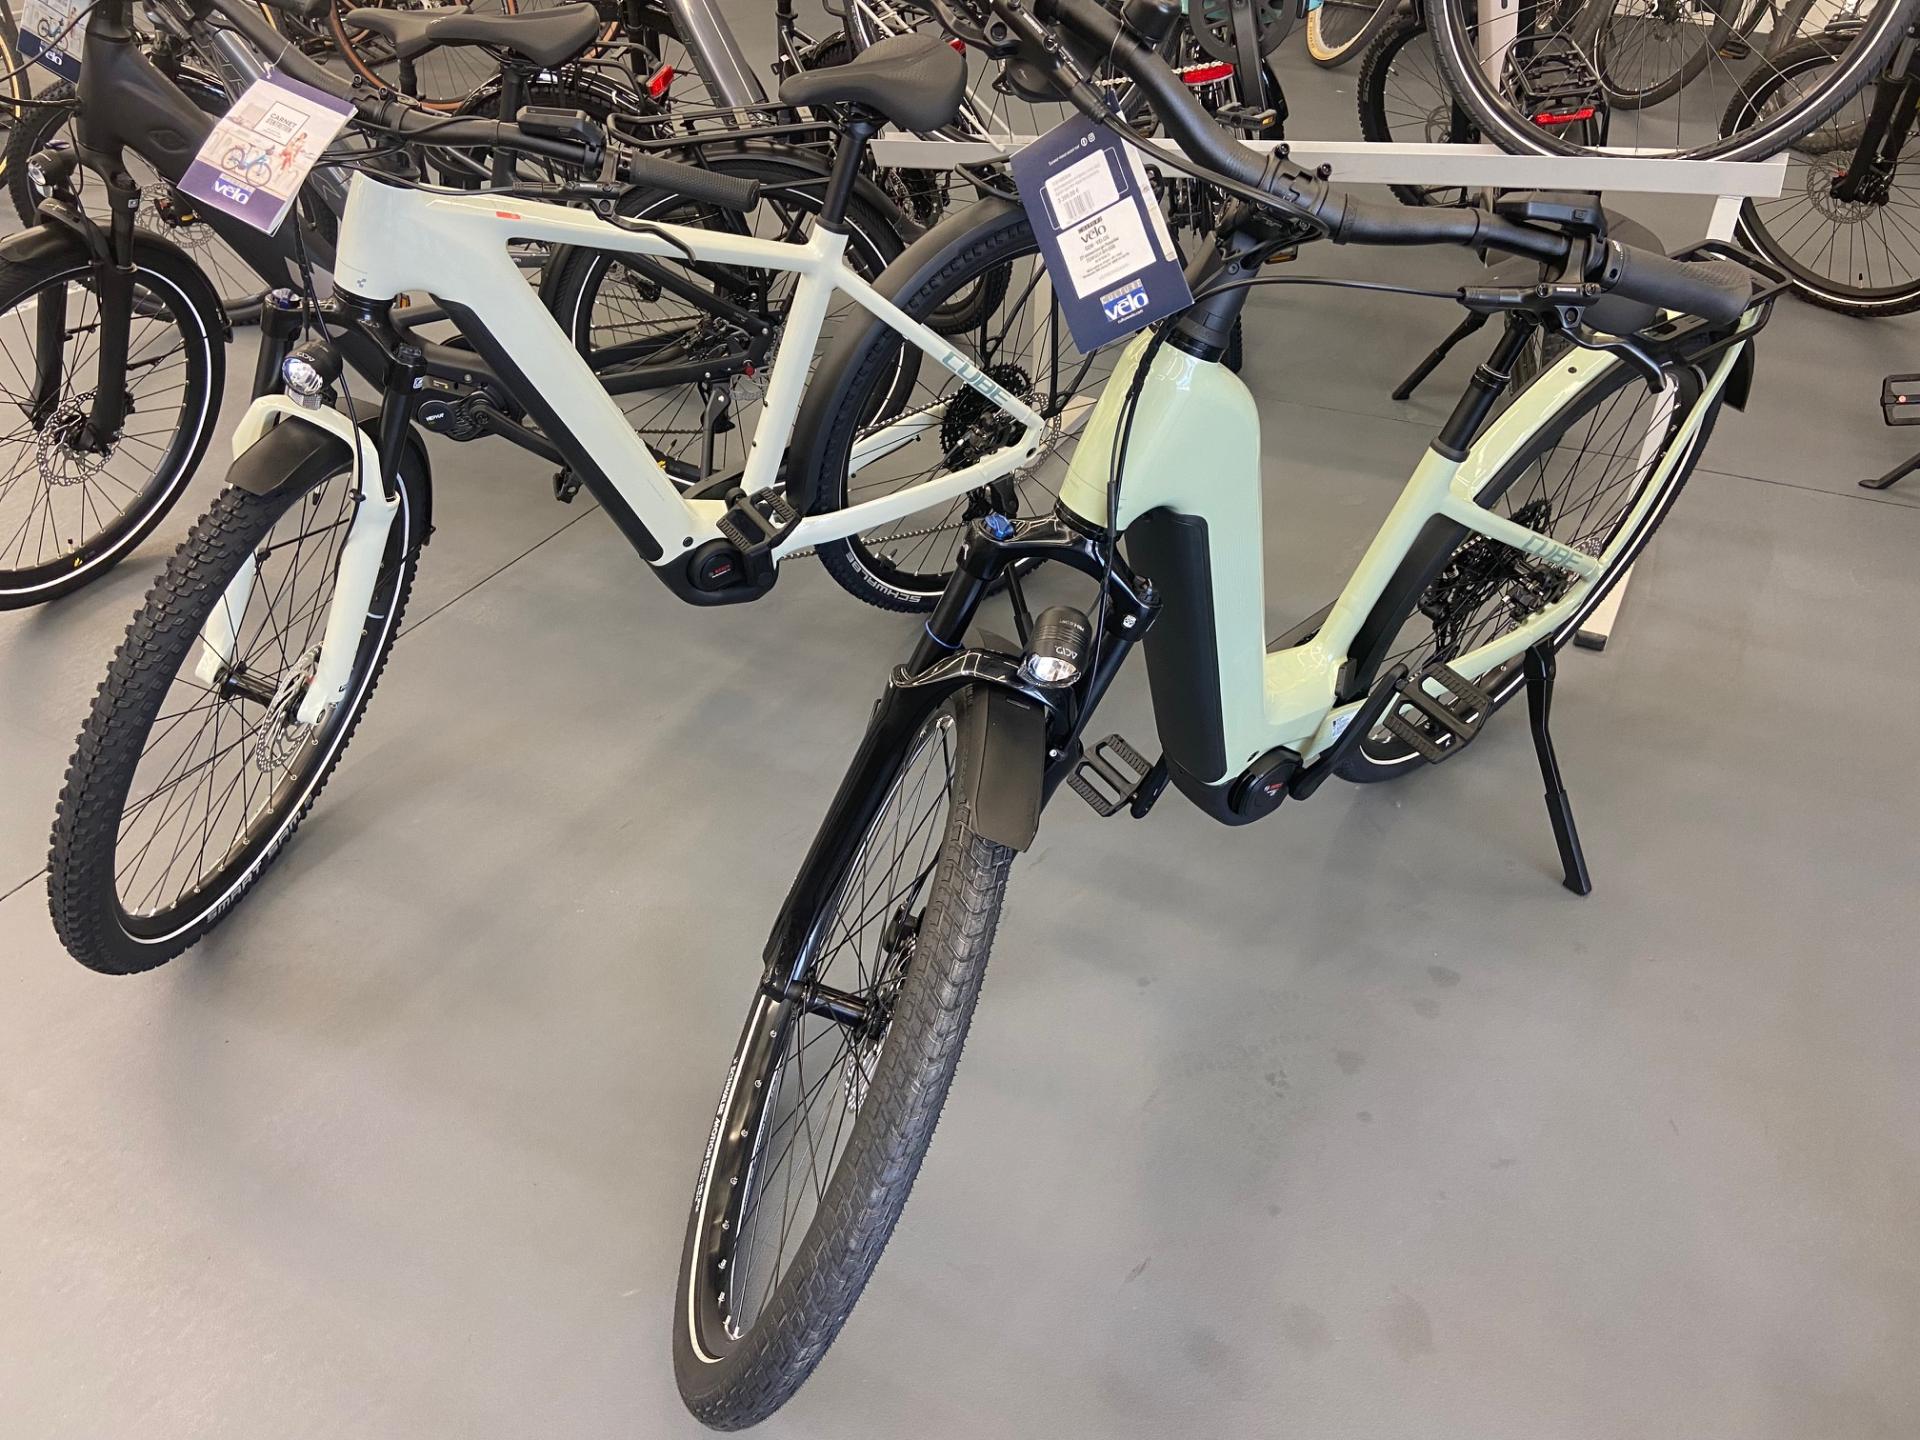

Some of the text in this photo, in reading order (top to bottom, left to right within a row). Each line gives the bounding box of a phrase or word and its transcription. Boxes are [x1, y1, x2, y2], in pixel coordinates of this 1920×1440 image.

[942, 351, 1012, 406] CUBE
[845, 551, 922, 603] SCHWALBE
[1522, 534, 1583, 569] CUBE
[206, 810, 301, 924] SMART SAM
[704, 1116, 721, 1159] MOTION
